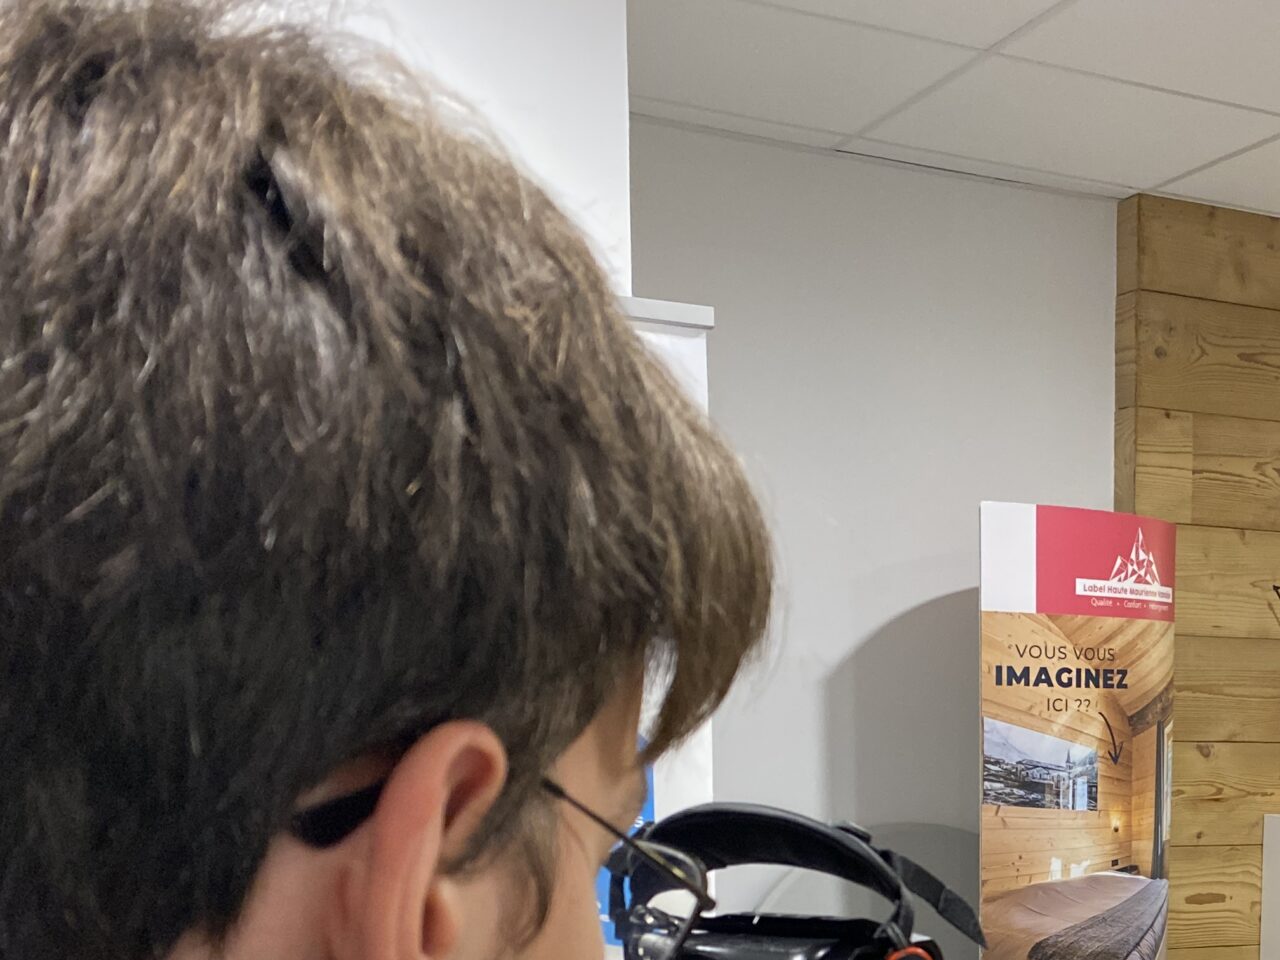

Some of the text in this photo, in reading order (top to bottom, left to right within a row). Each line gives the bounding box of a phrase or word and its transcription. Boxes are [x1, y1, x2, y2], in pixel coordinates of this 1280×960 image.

[1083, 584, 1106, 593] Label
[1107, 586, 1128, 595] Haute
[1014, 644, 1115, 662] VOUS VOUS
[995, 665, 1128, 689] IMAGINEZ
[1047, 698, 1091, 712] ICI ??
